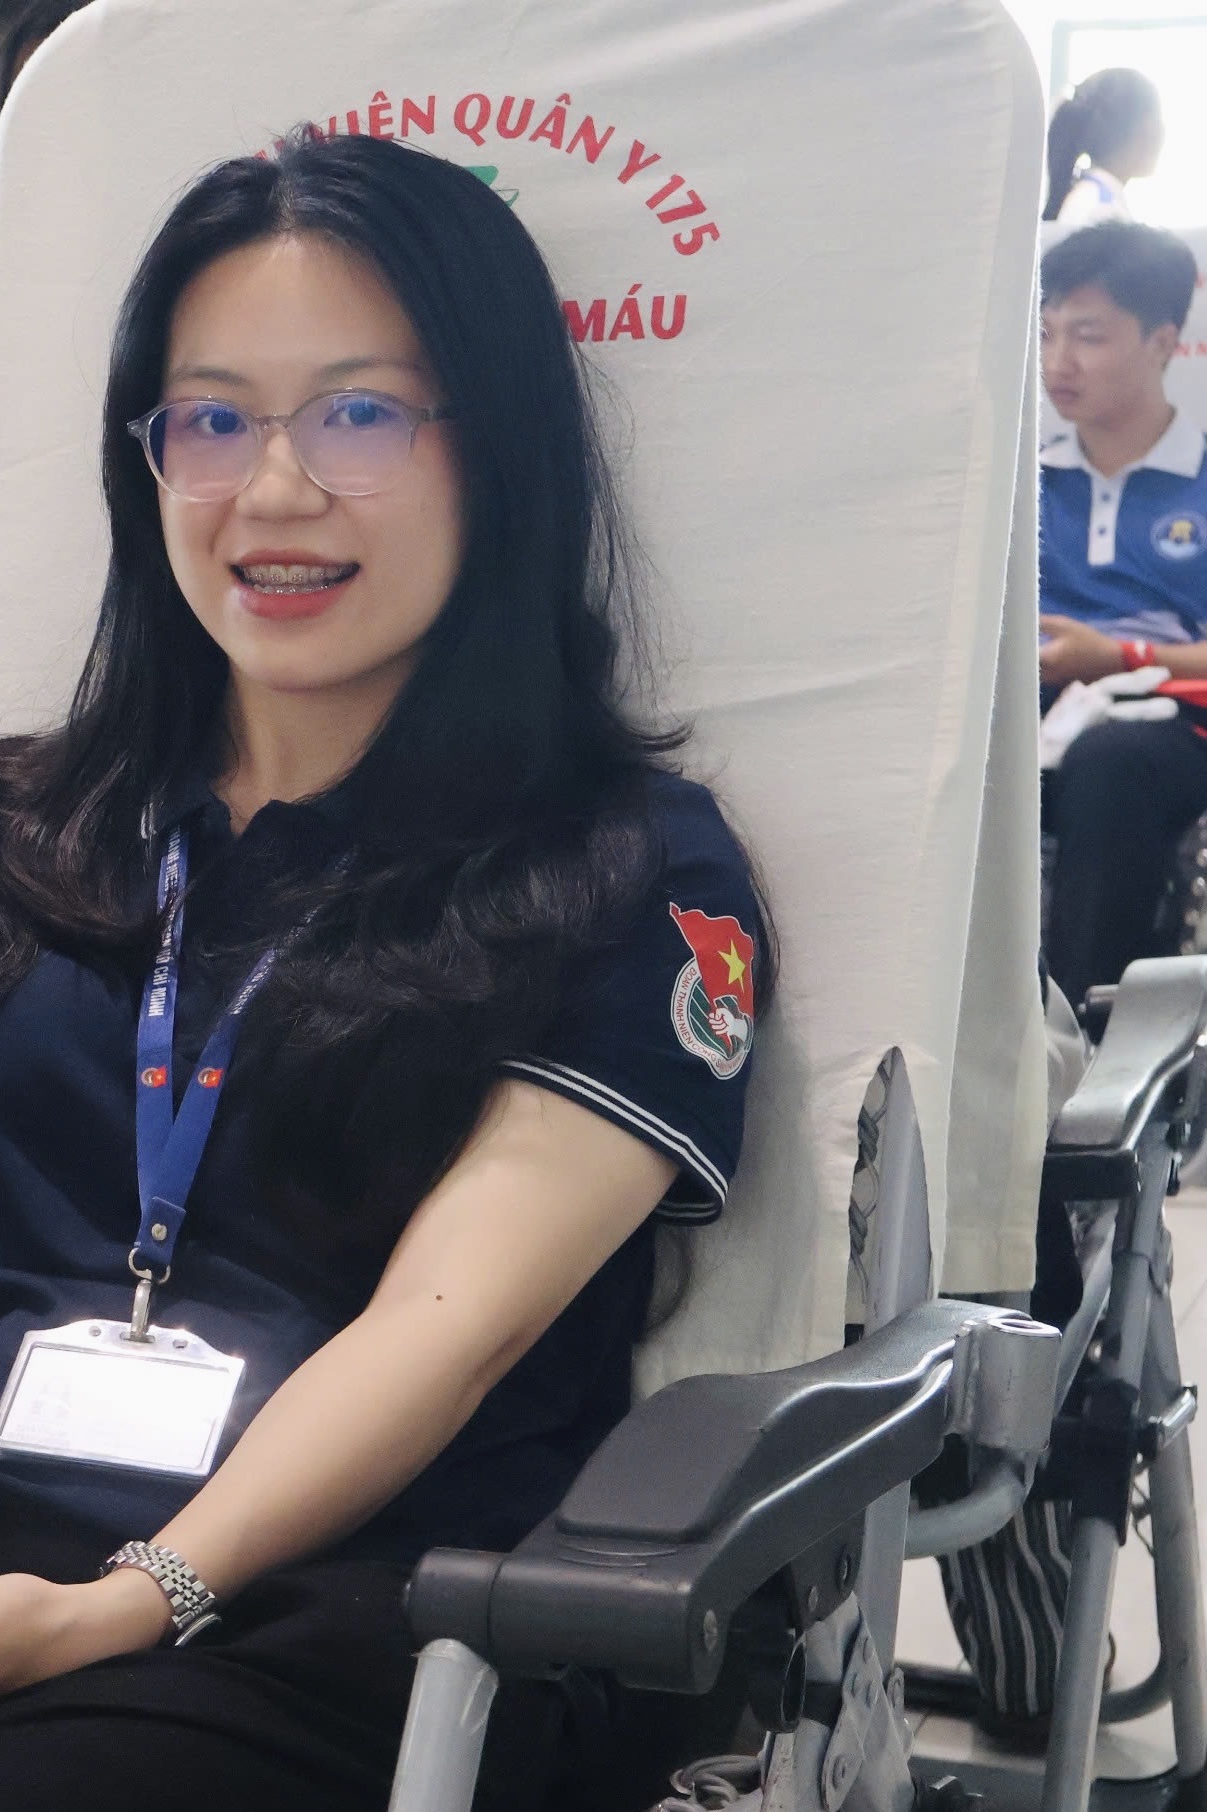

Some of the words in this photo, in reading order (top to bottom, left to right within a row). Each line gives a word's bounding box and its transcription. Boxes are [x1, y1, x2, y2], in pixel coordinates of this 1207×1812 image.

[453, 92, 615, 164] QUÂN
[617, 139, 662, 185] Y
[645, 173, 721, 256] 175
[562, 283, 687, 343] MÁU
[148, 987, 168, 1017] MINH
[676, 991, 687, 1022] THANH
